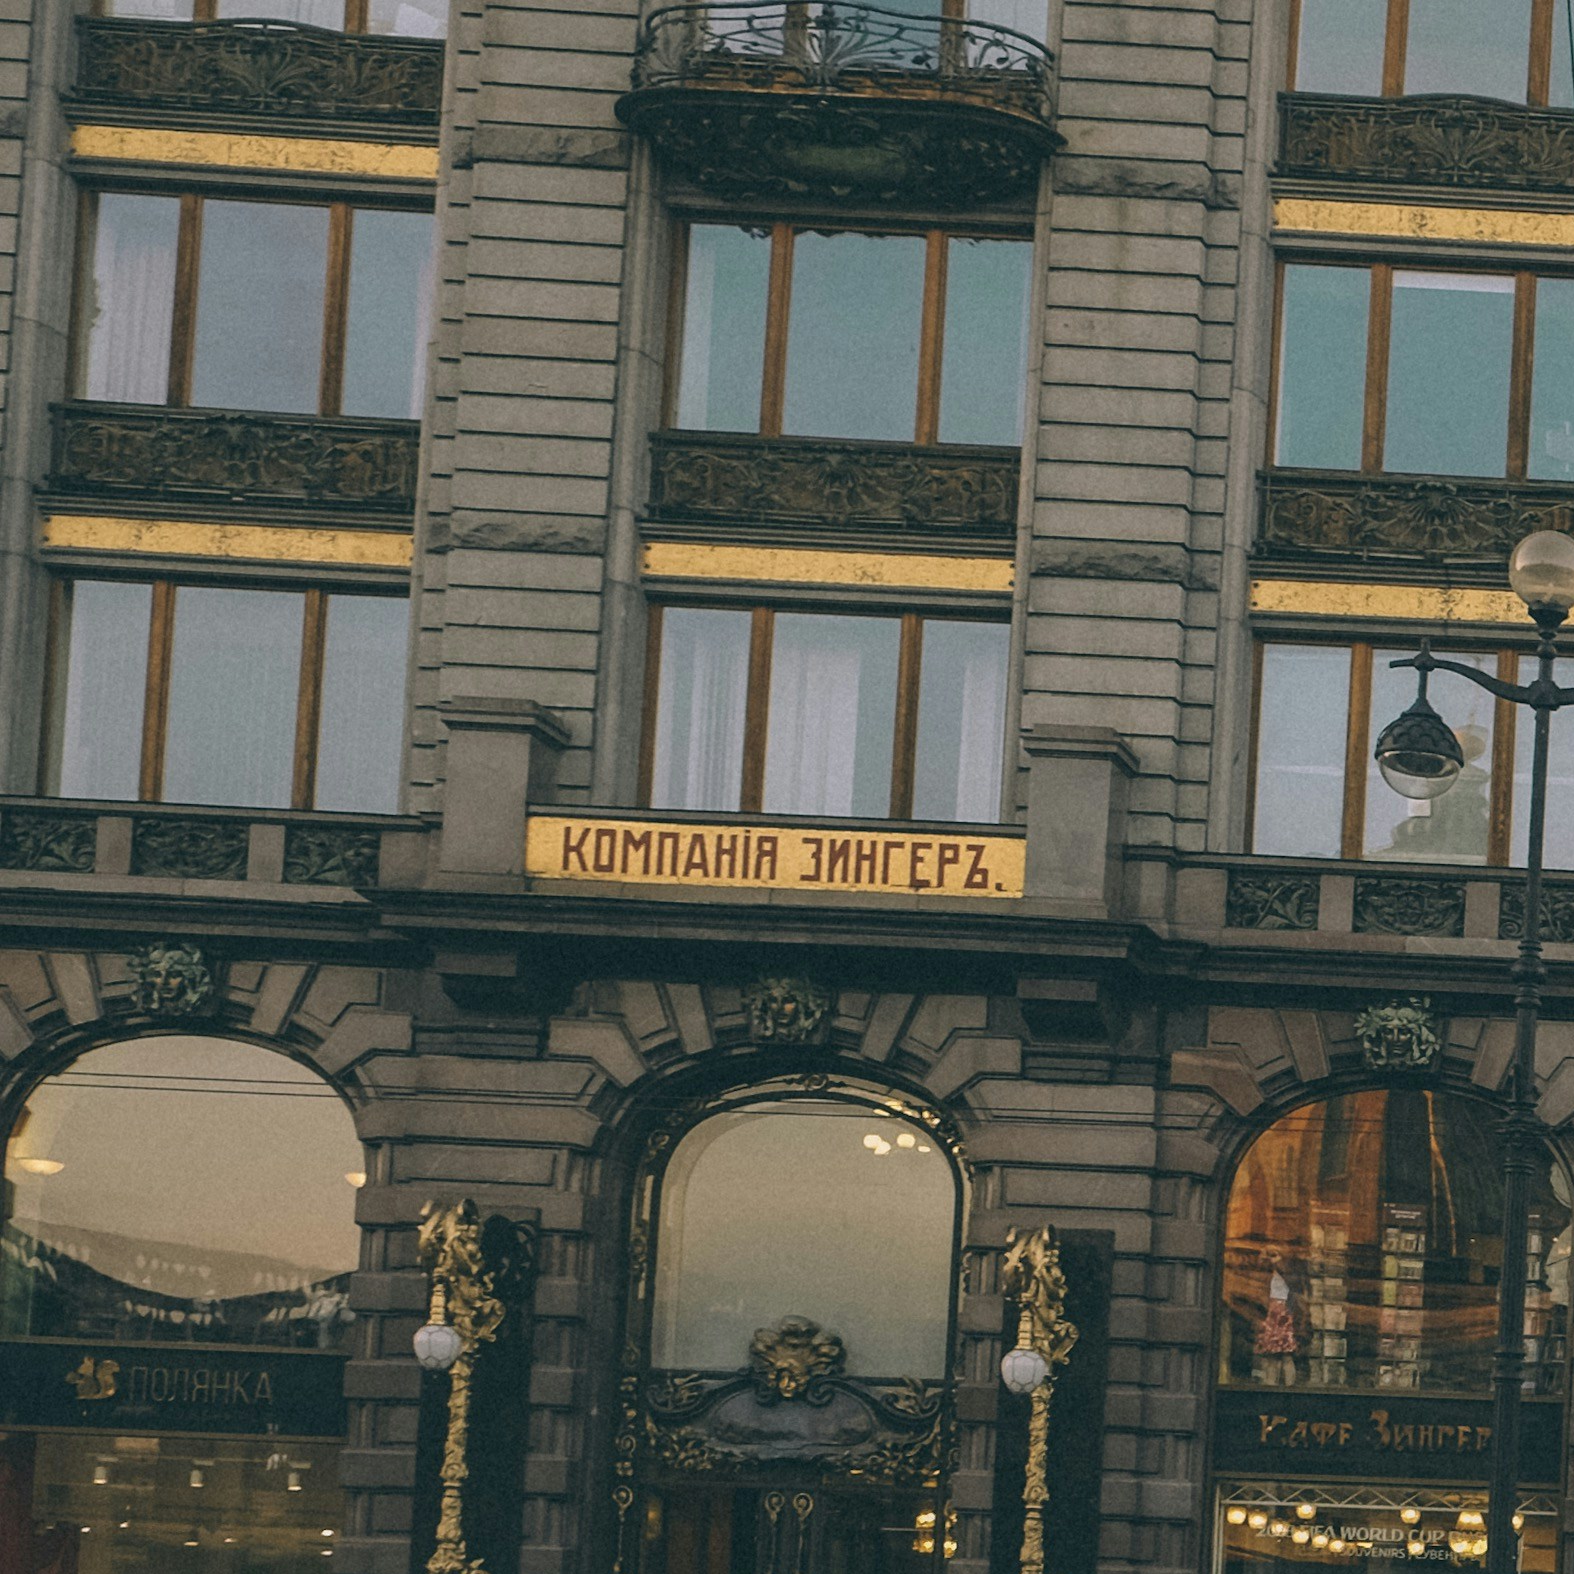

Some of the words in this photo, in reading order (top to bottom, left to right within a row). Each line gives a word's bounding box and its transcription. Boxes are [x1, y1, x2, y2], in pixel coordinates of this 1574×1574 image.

[129, 1365, 274, 1404] ПОЛЯНКА
[1258, 1414, 1354, 1448] КАФЕ
[1340, 1525, 1404, 1543] WORLD
[1407, 1528, 1446, 1544] CUP
